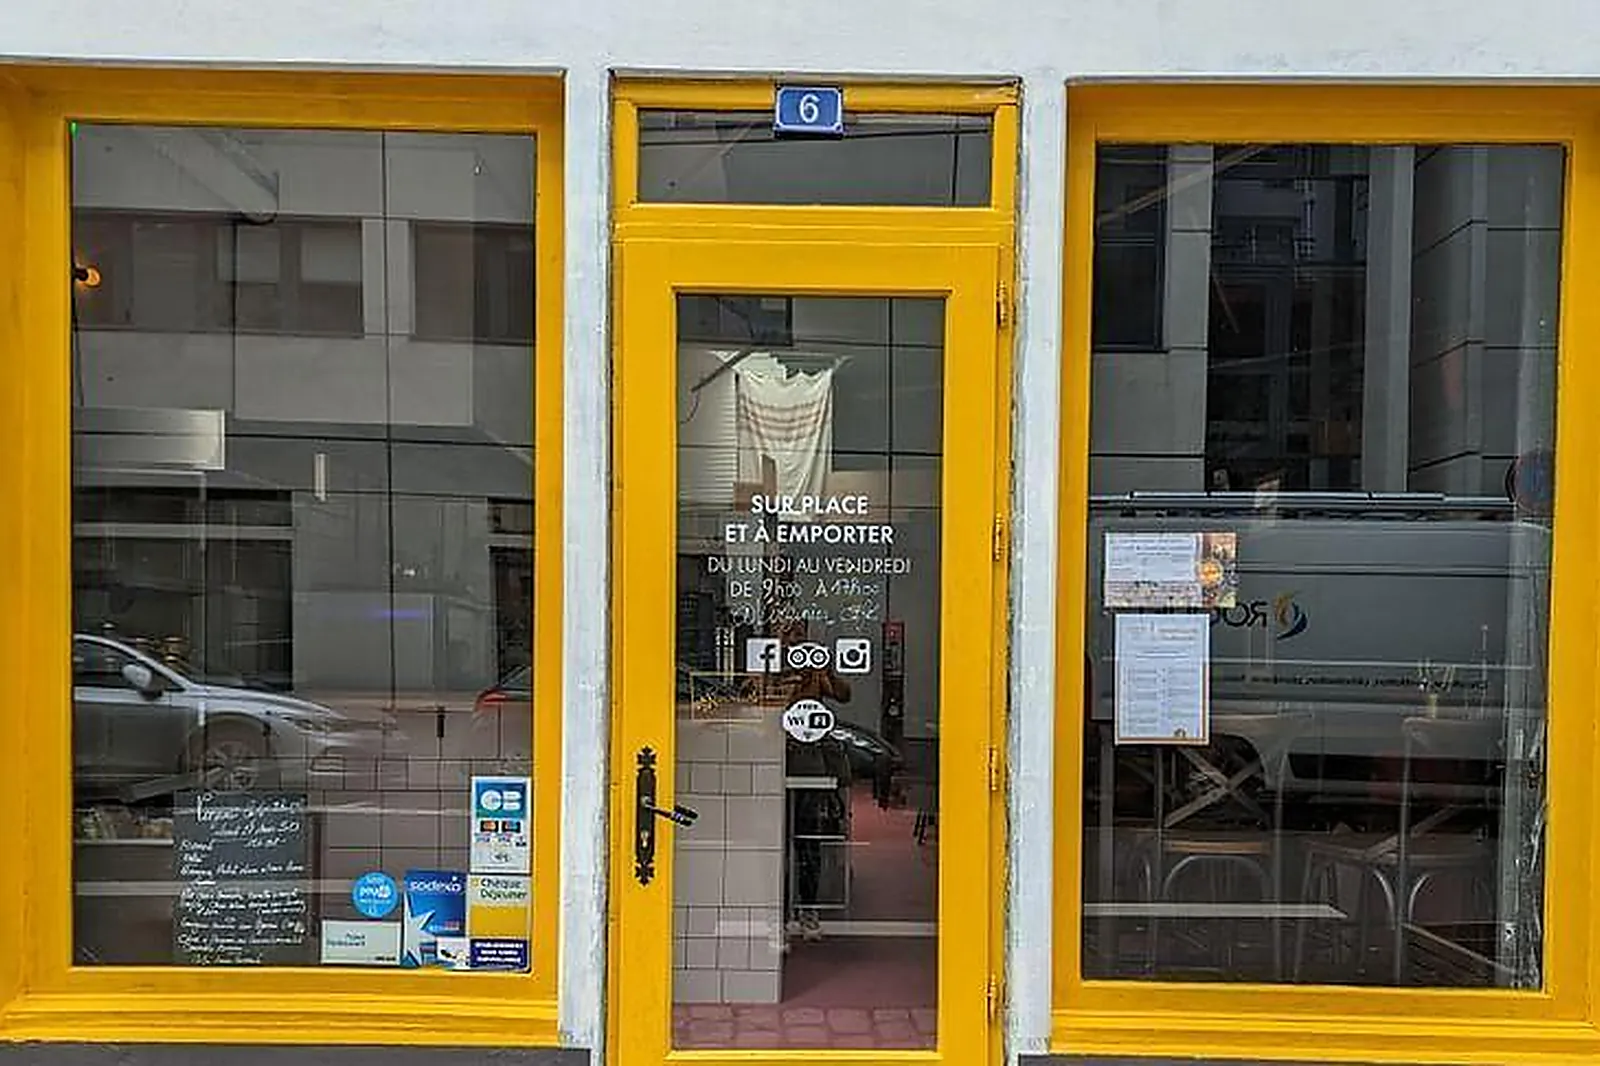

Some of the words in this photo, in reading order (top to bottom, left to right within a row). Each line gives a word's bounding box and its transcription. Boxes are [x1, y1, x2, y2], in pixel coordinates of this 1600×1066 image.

[800, 93, 820, 123] 6
[751, 494, 797, 515] SUR
[802, 495, 868, 515] PLACE
[725, 524, 749, 543] ET
[754, 519, 770, 543] À
[777, 524, 894, 544] EMPORTER
[707, 556, 733, 573] DU
[740, 556, 791, 573] LUNDI
[796, 556, 820, 573] AU
[824, 556, 911, 573] VENDREDI
[730, 580, 752, 598] DE
